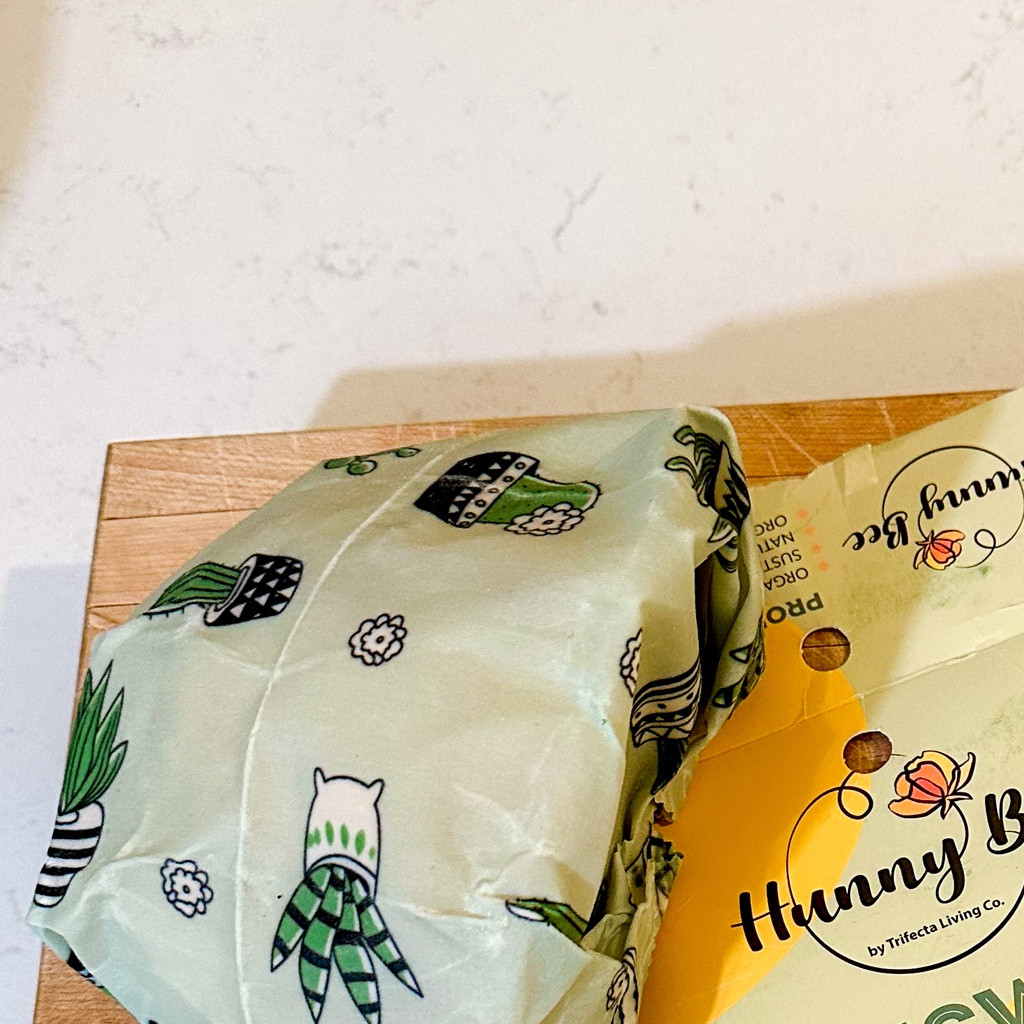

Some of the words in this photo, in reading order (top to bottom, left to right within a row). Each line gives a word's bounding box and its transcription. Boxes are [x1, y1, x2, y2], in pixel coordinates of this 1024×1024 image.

[842, 511, 909, 551] Bee
[764, 592, 824, 628] PRO
[731, 837, 965, 952] Hunny
[867, 943, 885, 957] by
[886, 922, 938, 950] Trifecta
[939, 903, 982, 930] Living
[983, 898, 1005, 918] Co.
